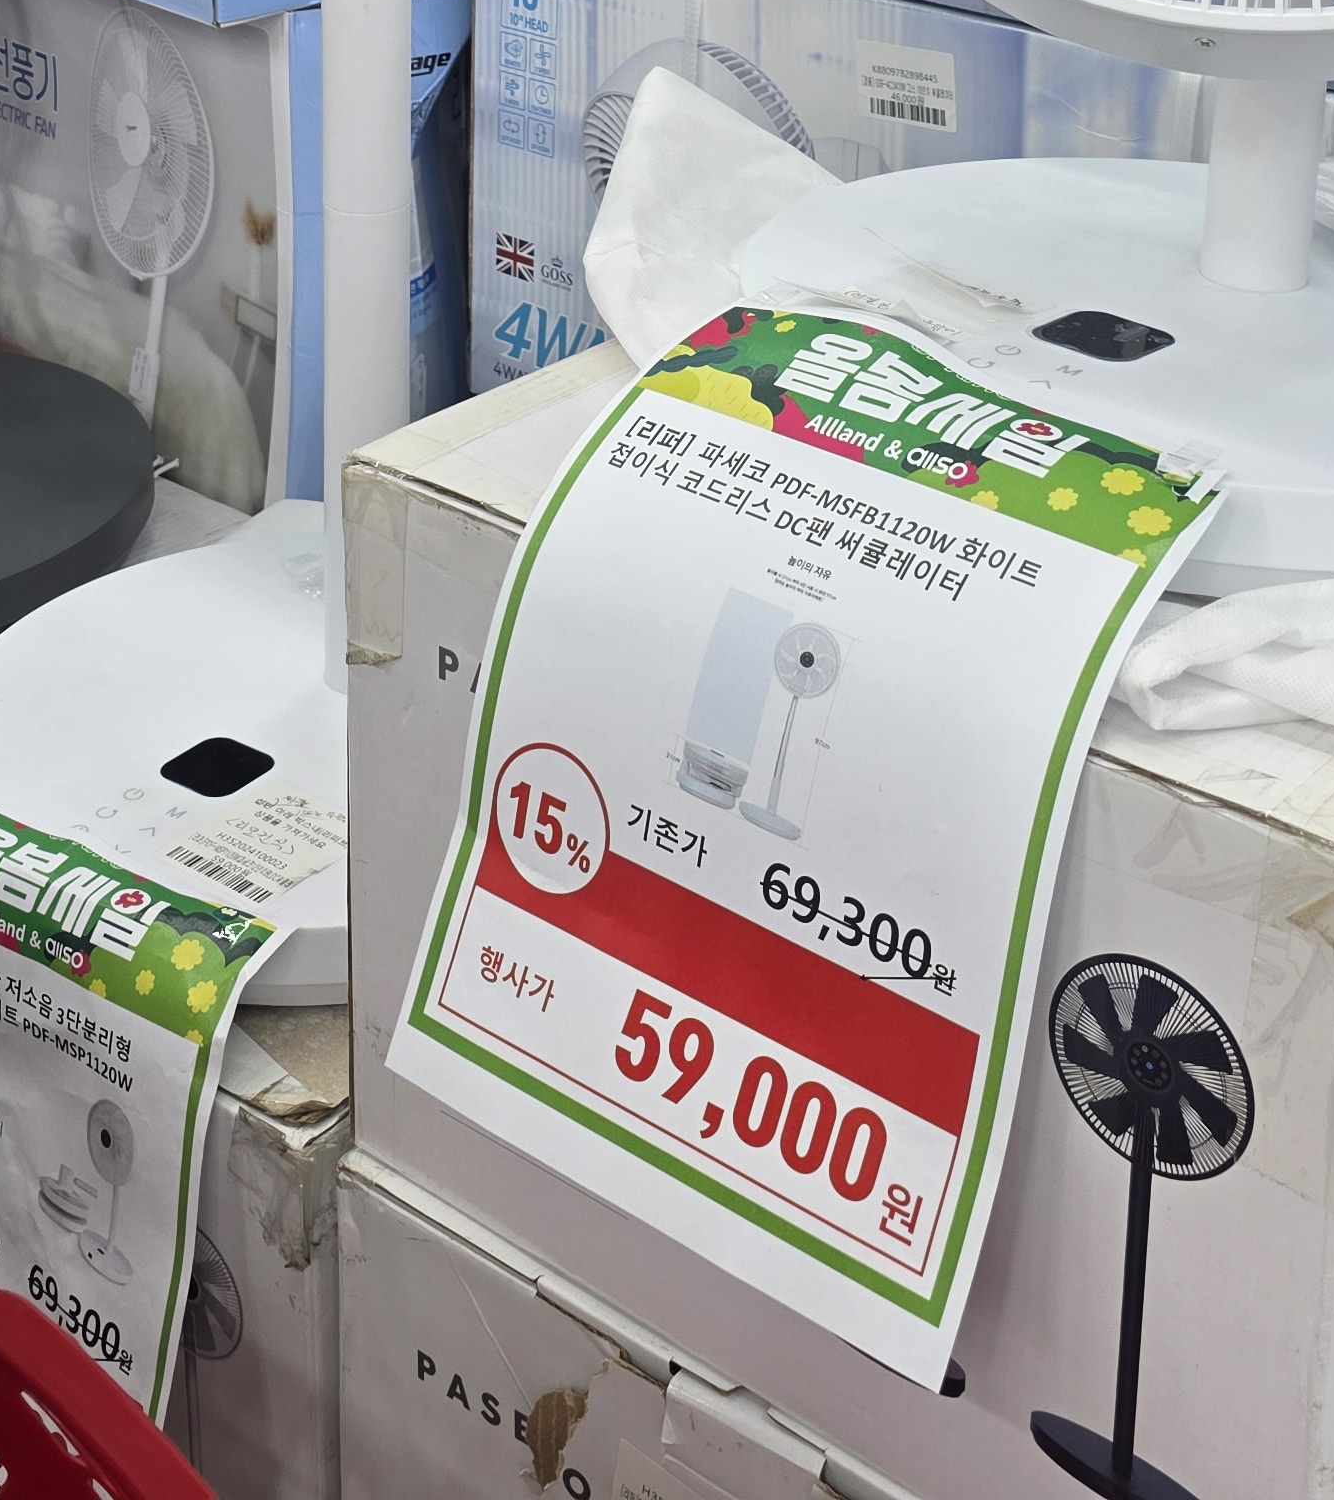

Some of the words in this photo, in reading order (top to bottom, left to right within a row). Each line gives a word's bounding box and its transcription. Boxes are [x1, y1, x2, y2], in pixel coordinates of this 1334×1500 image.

[524, 15, 550, 35] HEAD
[34, 115, 57, 141] FAN
[540, 266, 574, 286] GOSS
[773, 332, 1091, 479] 올봄세일
[883, 439, 903, 461] &
[607, 441, 677, 486] 접이식
[675, 465, 772, 523] 코드리스
[773, 507, 835, 548] DC팬
[834, 526, 971, 603] 써큘레이터
[624, 414, 697, 460] [리퍼]
[703, 438, 772, 485] 파세코
[769, 470, 957, 557] PDF-MSFB1120W
[955, 534, 1044, 588] 화이트
[786, 553, 815, 574] 높이의
[812, 564, 833, 581] 자유
[214, 830, 289, 871] H352024100023
[508, 779, 592, 874] 15%
[625, 802, 708, 868] 기존가
[29, 931, 42, 949] &
[760, 861, 958, 996] 69,300원
[479, 944, 556, 1013] 행사가
[3, 975, 54, 1018] 저소음
[55, 1006, 132, 1064] 3단분리형
[21, 1018, 134, 1094] PDF-MSP1120W
[613, 986, 925, 1248] 59,000원
[415, 1349, 593, 1500] PASEO
